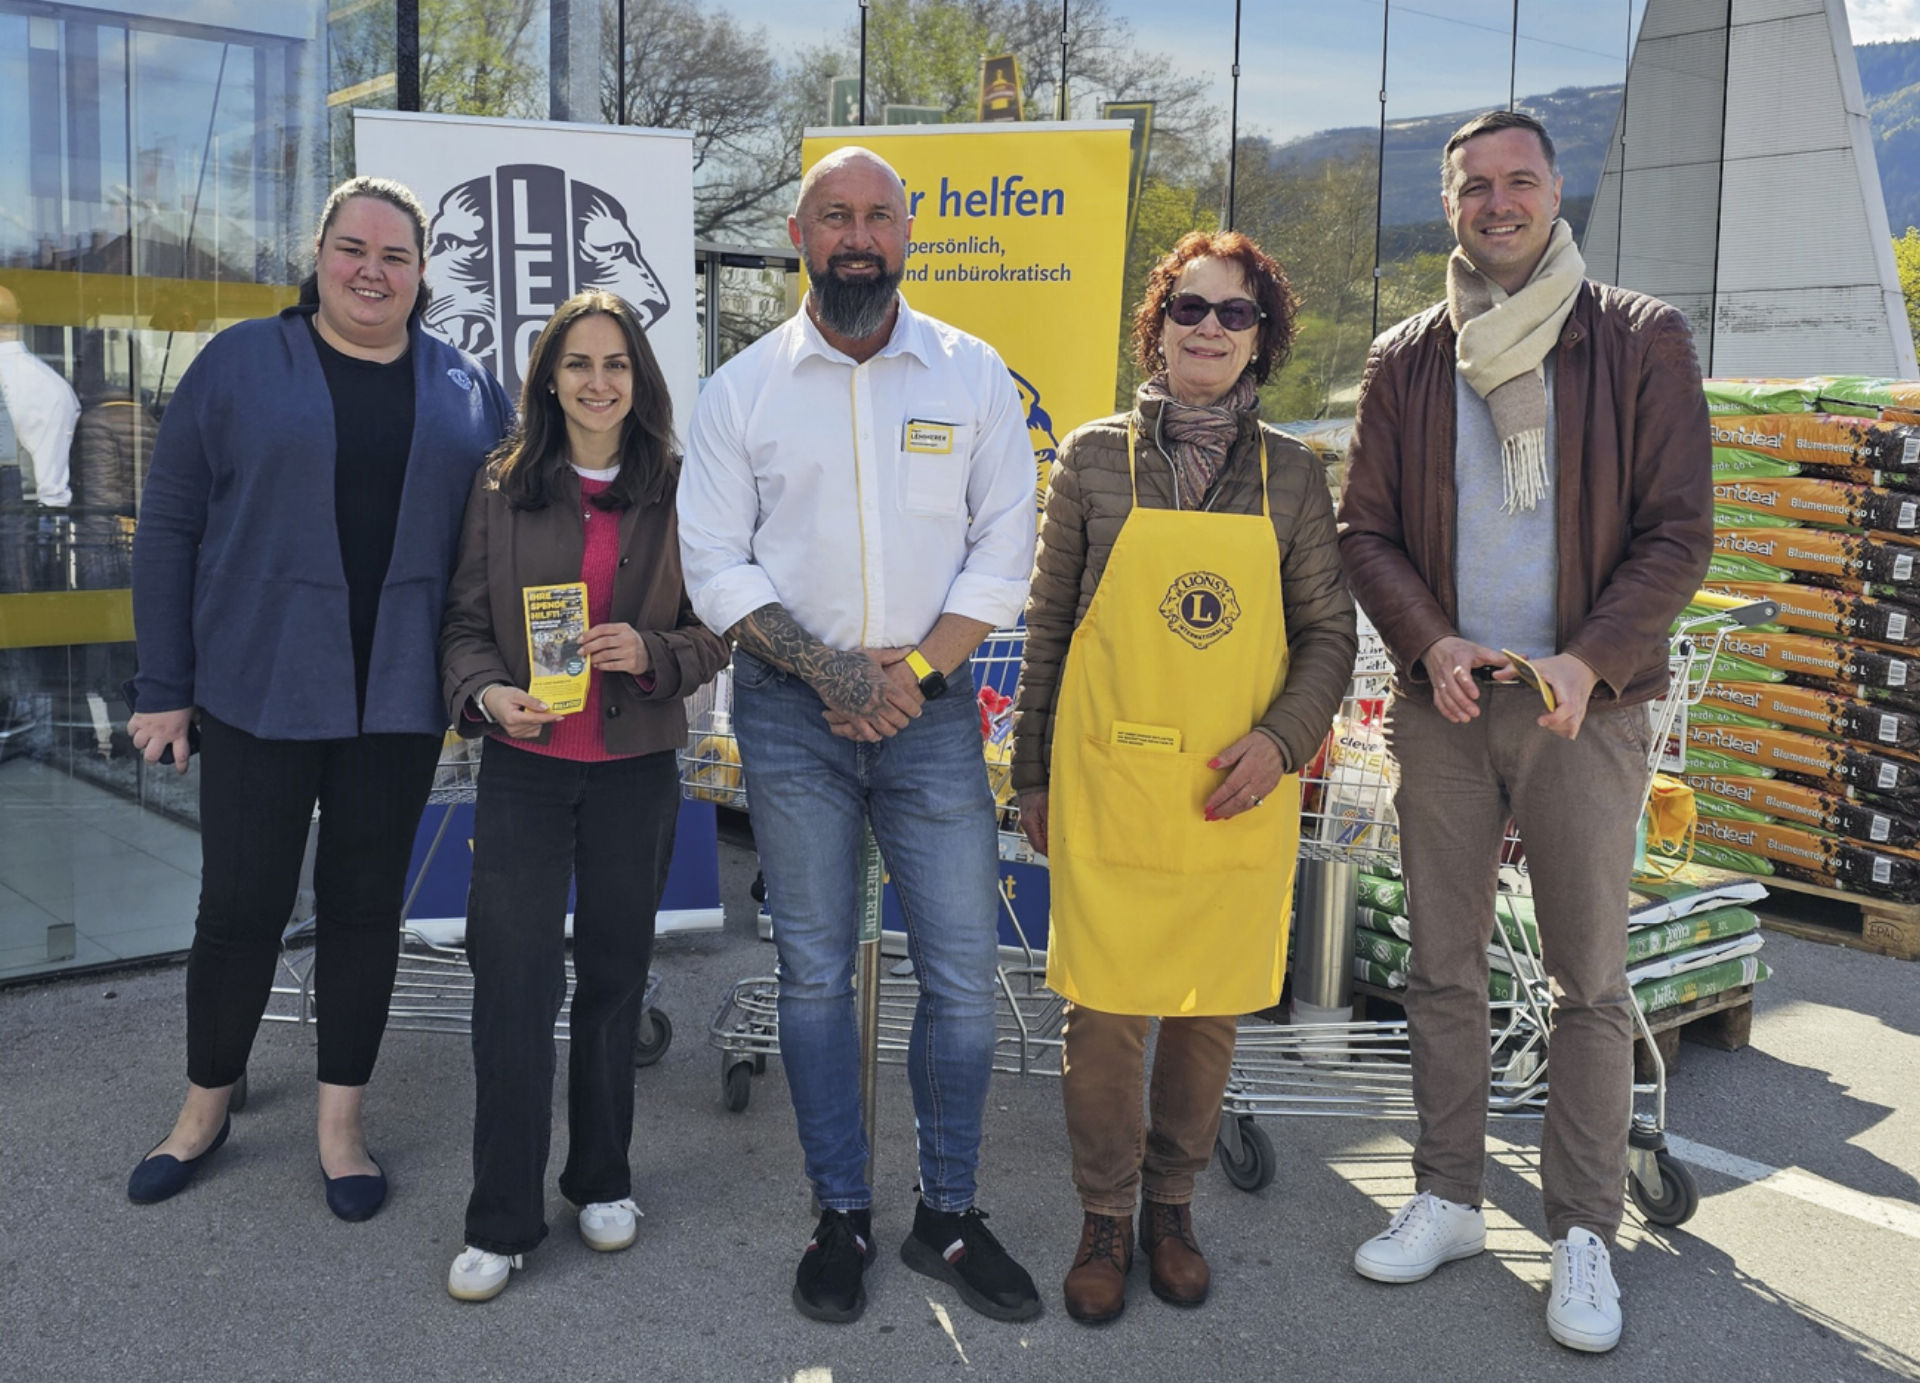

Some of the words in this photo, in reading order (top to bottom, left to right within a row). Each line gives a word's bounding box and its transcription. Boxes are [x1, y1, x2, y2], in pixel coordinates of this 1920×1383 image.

[939, 175, 1065, 217] helfen
[907, 235, 1005, 259] persönlich,
[906, 264, 928, 281] nd
[935, 263, 1071, 281] unbürokratisch
[1797, 439, 1855, 454] Blumenerde
[1859, 447, 1871, 456] 40
[1713, 484, 1777, 506] orideal
[1791, 498, 1850, 515] Blumenerde
[1854, 508, 1868, 518] 40
[1788, 547, 1847, 565] Blumenerde
[1851, 559, 1864, 569] 40
[1182, 575, 1222, 591] LIONS
[1190, 594, 1213, 622] L
[1780, 604, 1840, 623] Blumenerde
[1843, 616, 1856, 626] 40
[1781, 651, 1840, 670] Blumenerde
[1843, 664, 1857, 674] 40
[1773, 701, 1832, 722] Blumenerde
[1835, 716, 1848, 727] 40
[1772, 749, 1831, 769] Blumenerde
[1835, 764, 1848, 775] 40
[1766, 796, 1824, 820] Blumenerde
[1827, 815, 1840, 825] 40
[1768, 838, 1826, 862] Blumenerde
[1829, 857, 1842, 867] 40
[866, 865, 879, 897] HIER
[865, 901, 878, 933] REIN
